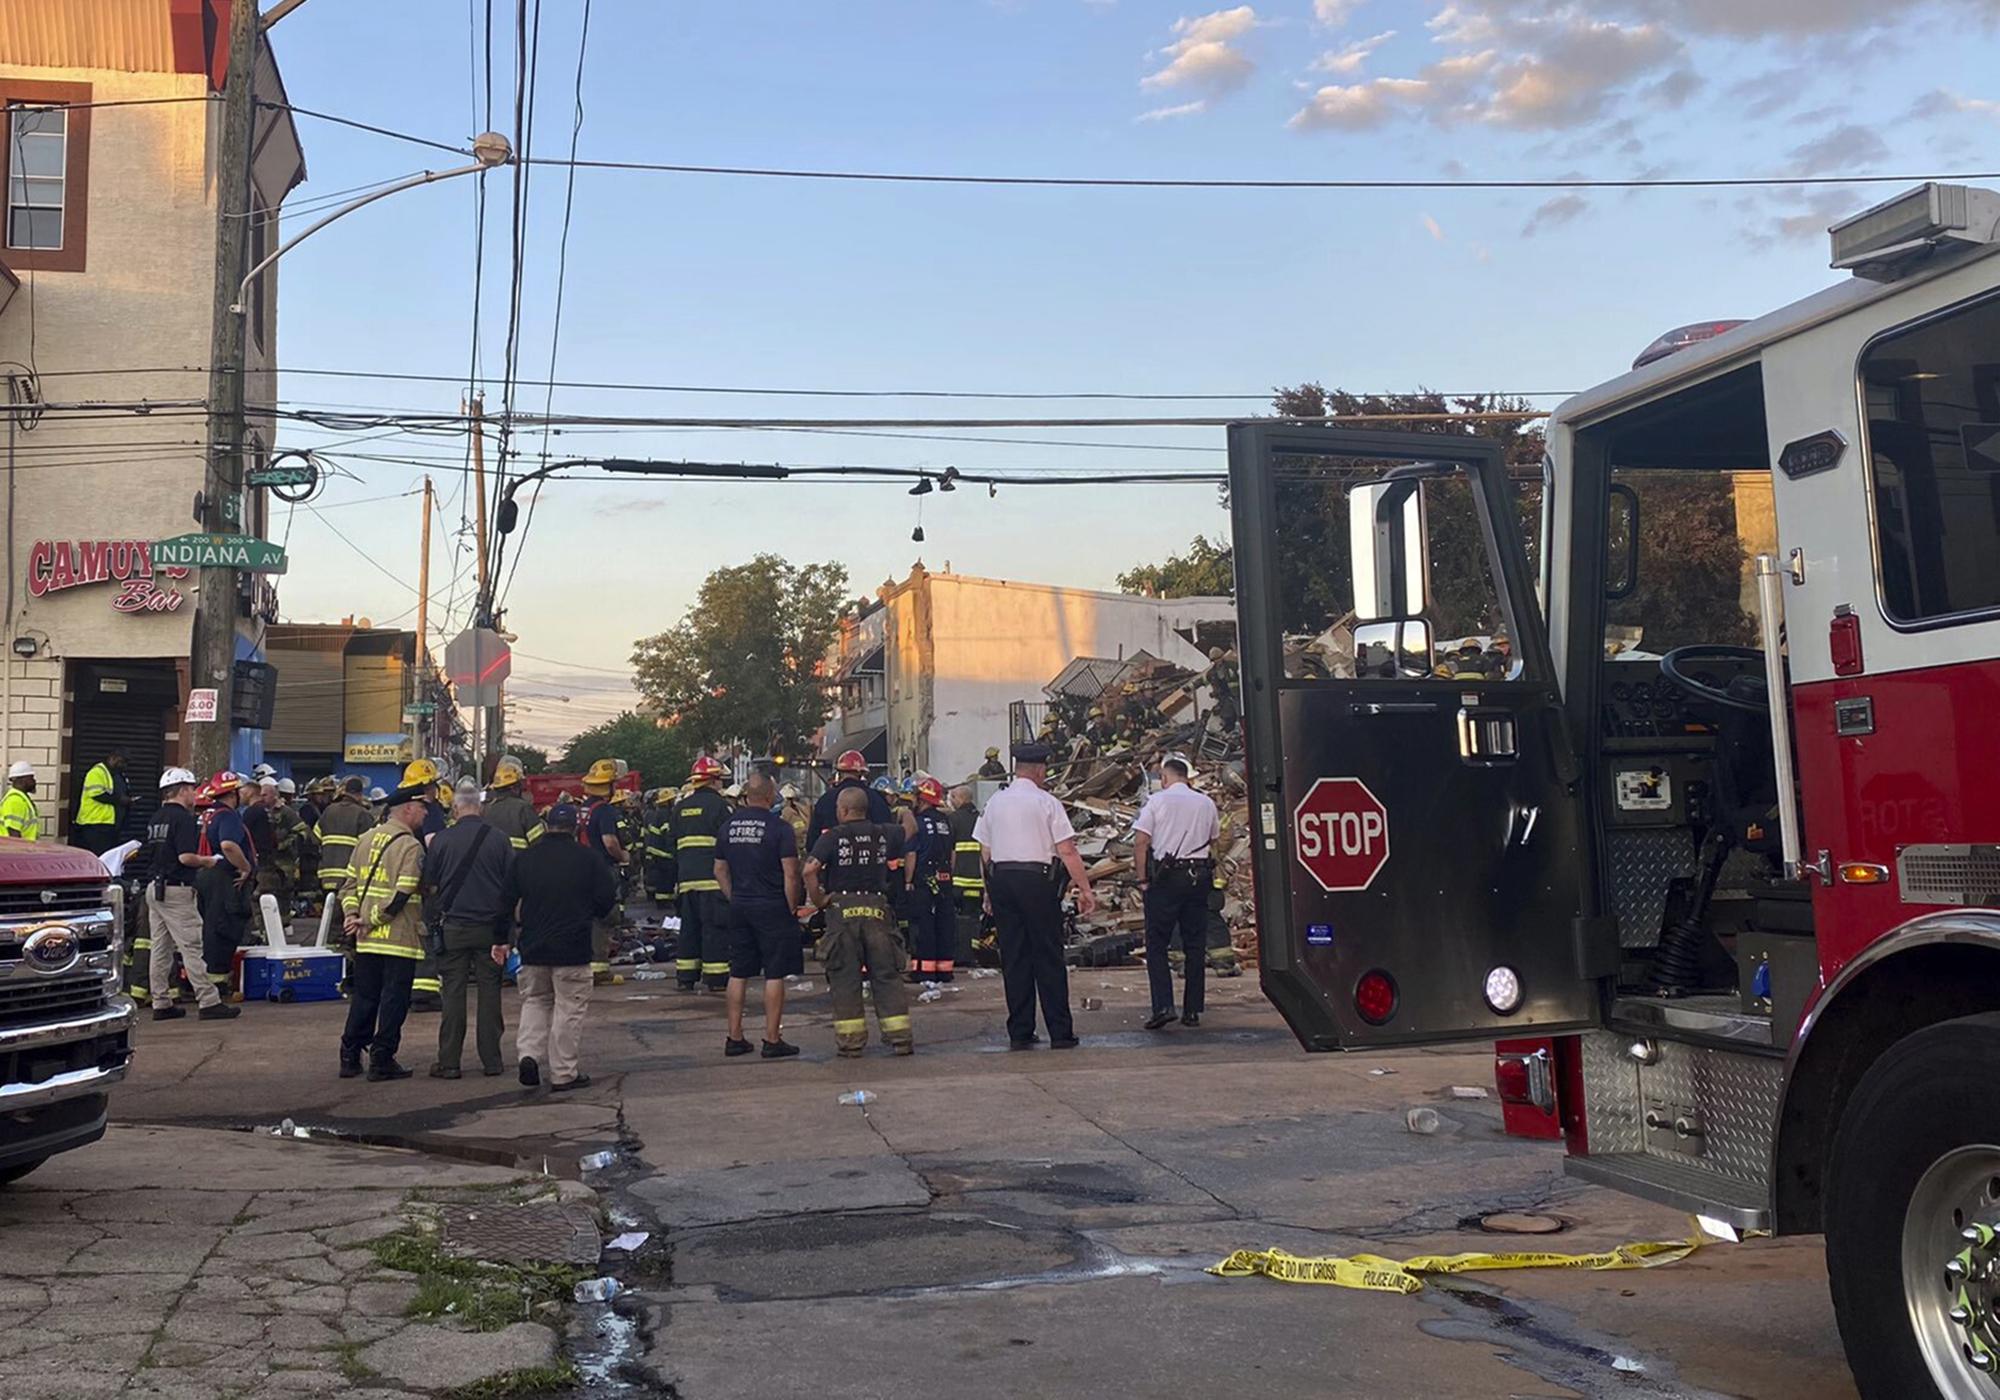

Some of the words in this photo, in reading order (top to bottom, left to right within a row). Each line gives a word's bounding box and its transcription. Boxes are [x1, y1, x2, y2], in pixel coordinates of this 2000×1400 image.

[154, 545, 250, 564] INDIANA
[261, 553, 281, 564] AV
[29, 538, 190, 597] CAMUY
[112, 579, 183, 612] Bar
[736, 827, 757, 836] FIRE
[1300, 811, 1383, 857] STOP
[43, 938, 70, 958] Ford
[1286, 1264, 1296, 1278] DO
[1300, 1265, 1312, 1279] NOT
[1313, 1264, 1336, 1281] CROSS
[1363, 1270, 1387, 1288] POLICE
[1388, 1272, 1407, 1291] LINE
